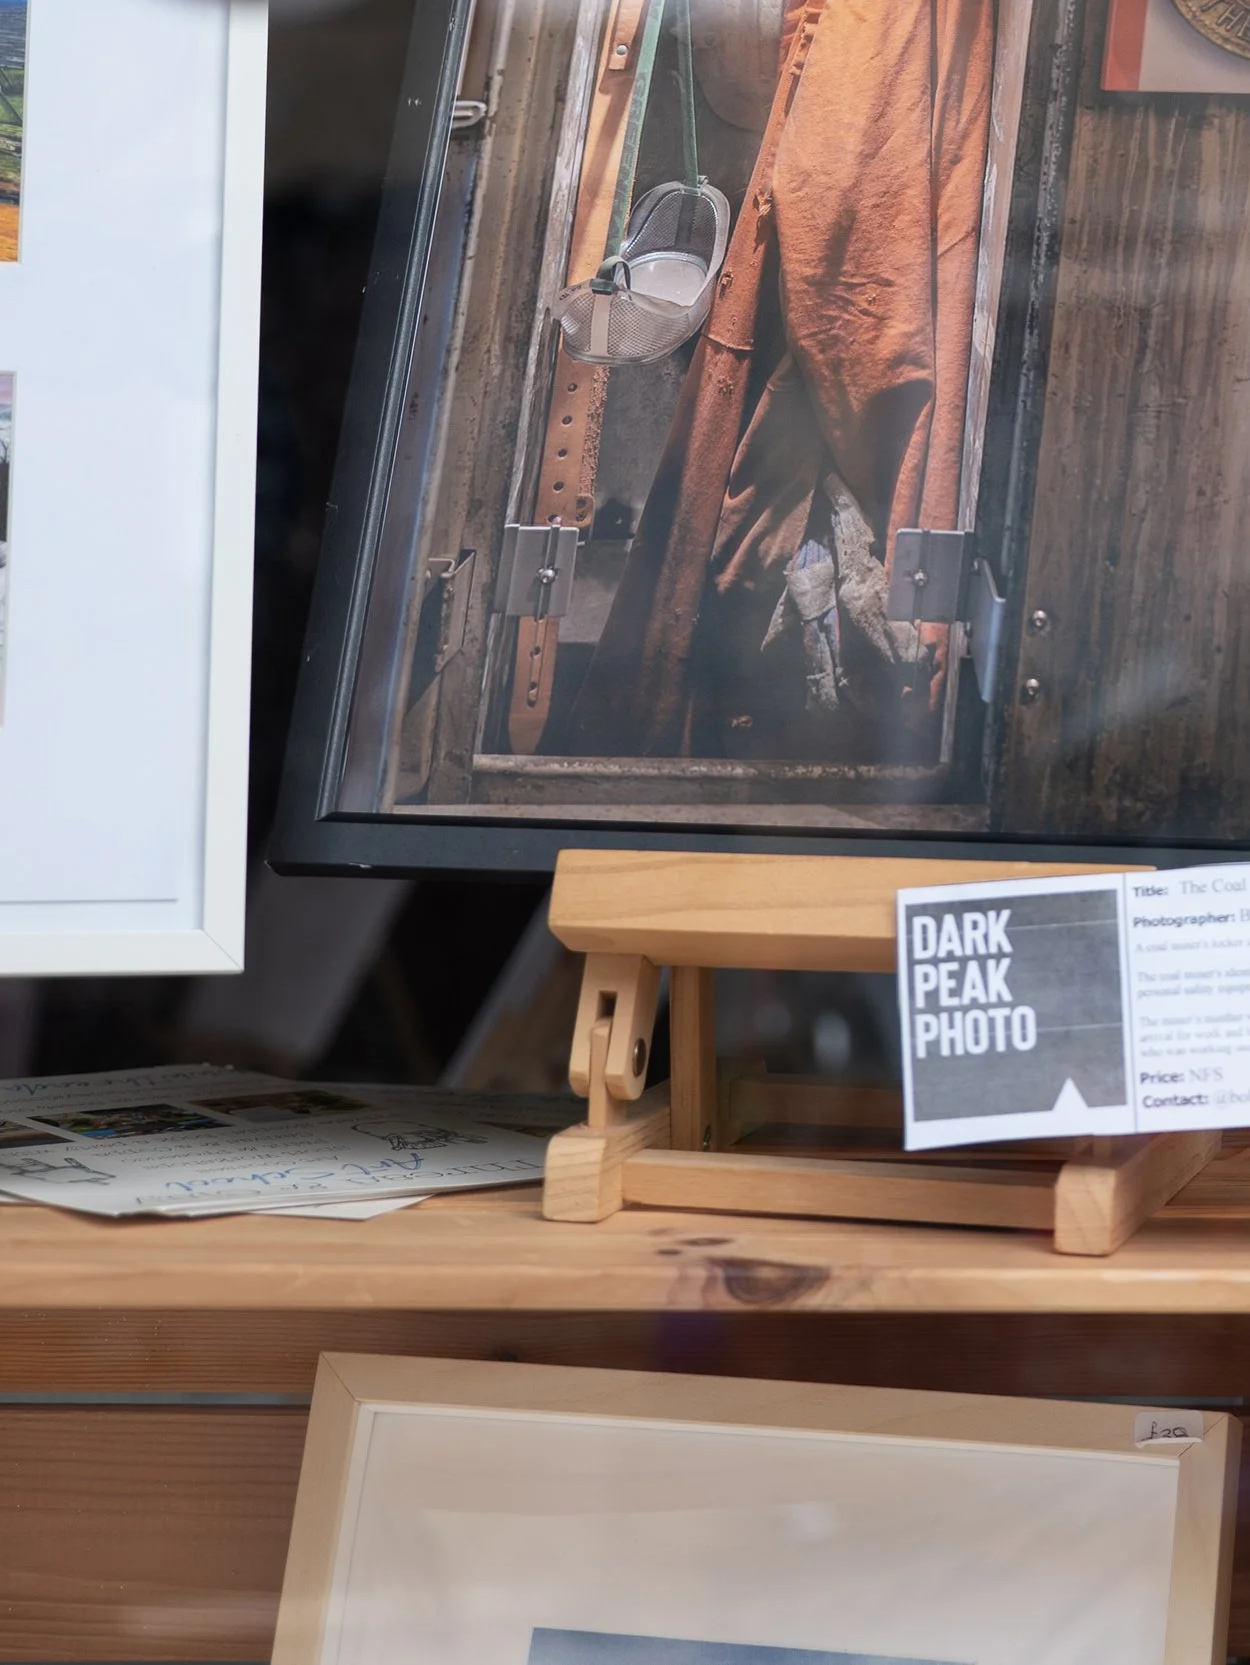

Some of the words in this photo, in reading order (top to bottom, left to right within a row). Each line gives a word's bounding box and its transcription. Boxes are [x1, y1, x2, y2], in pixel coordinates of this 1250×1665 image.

[1133, 886, 1169, 897] Title:
[1179, 880, 1207, 895] The
[1211, 877, 1246, 892] Coal
[1133, 913, 1235, 928] Photographer:
[911, 909, 1014, 960] DARK
[912, 957, 1014, 1009] PEAK
[914, 1005, 1038, 1059] PHOTO
[1140, 1071, 1184, 1085] Price:
[1189, 1067, 1224, 1082] NFS
[1143, 1093, 1210, 1108] Contact:
